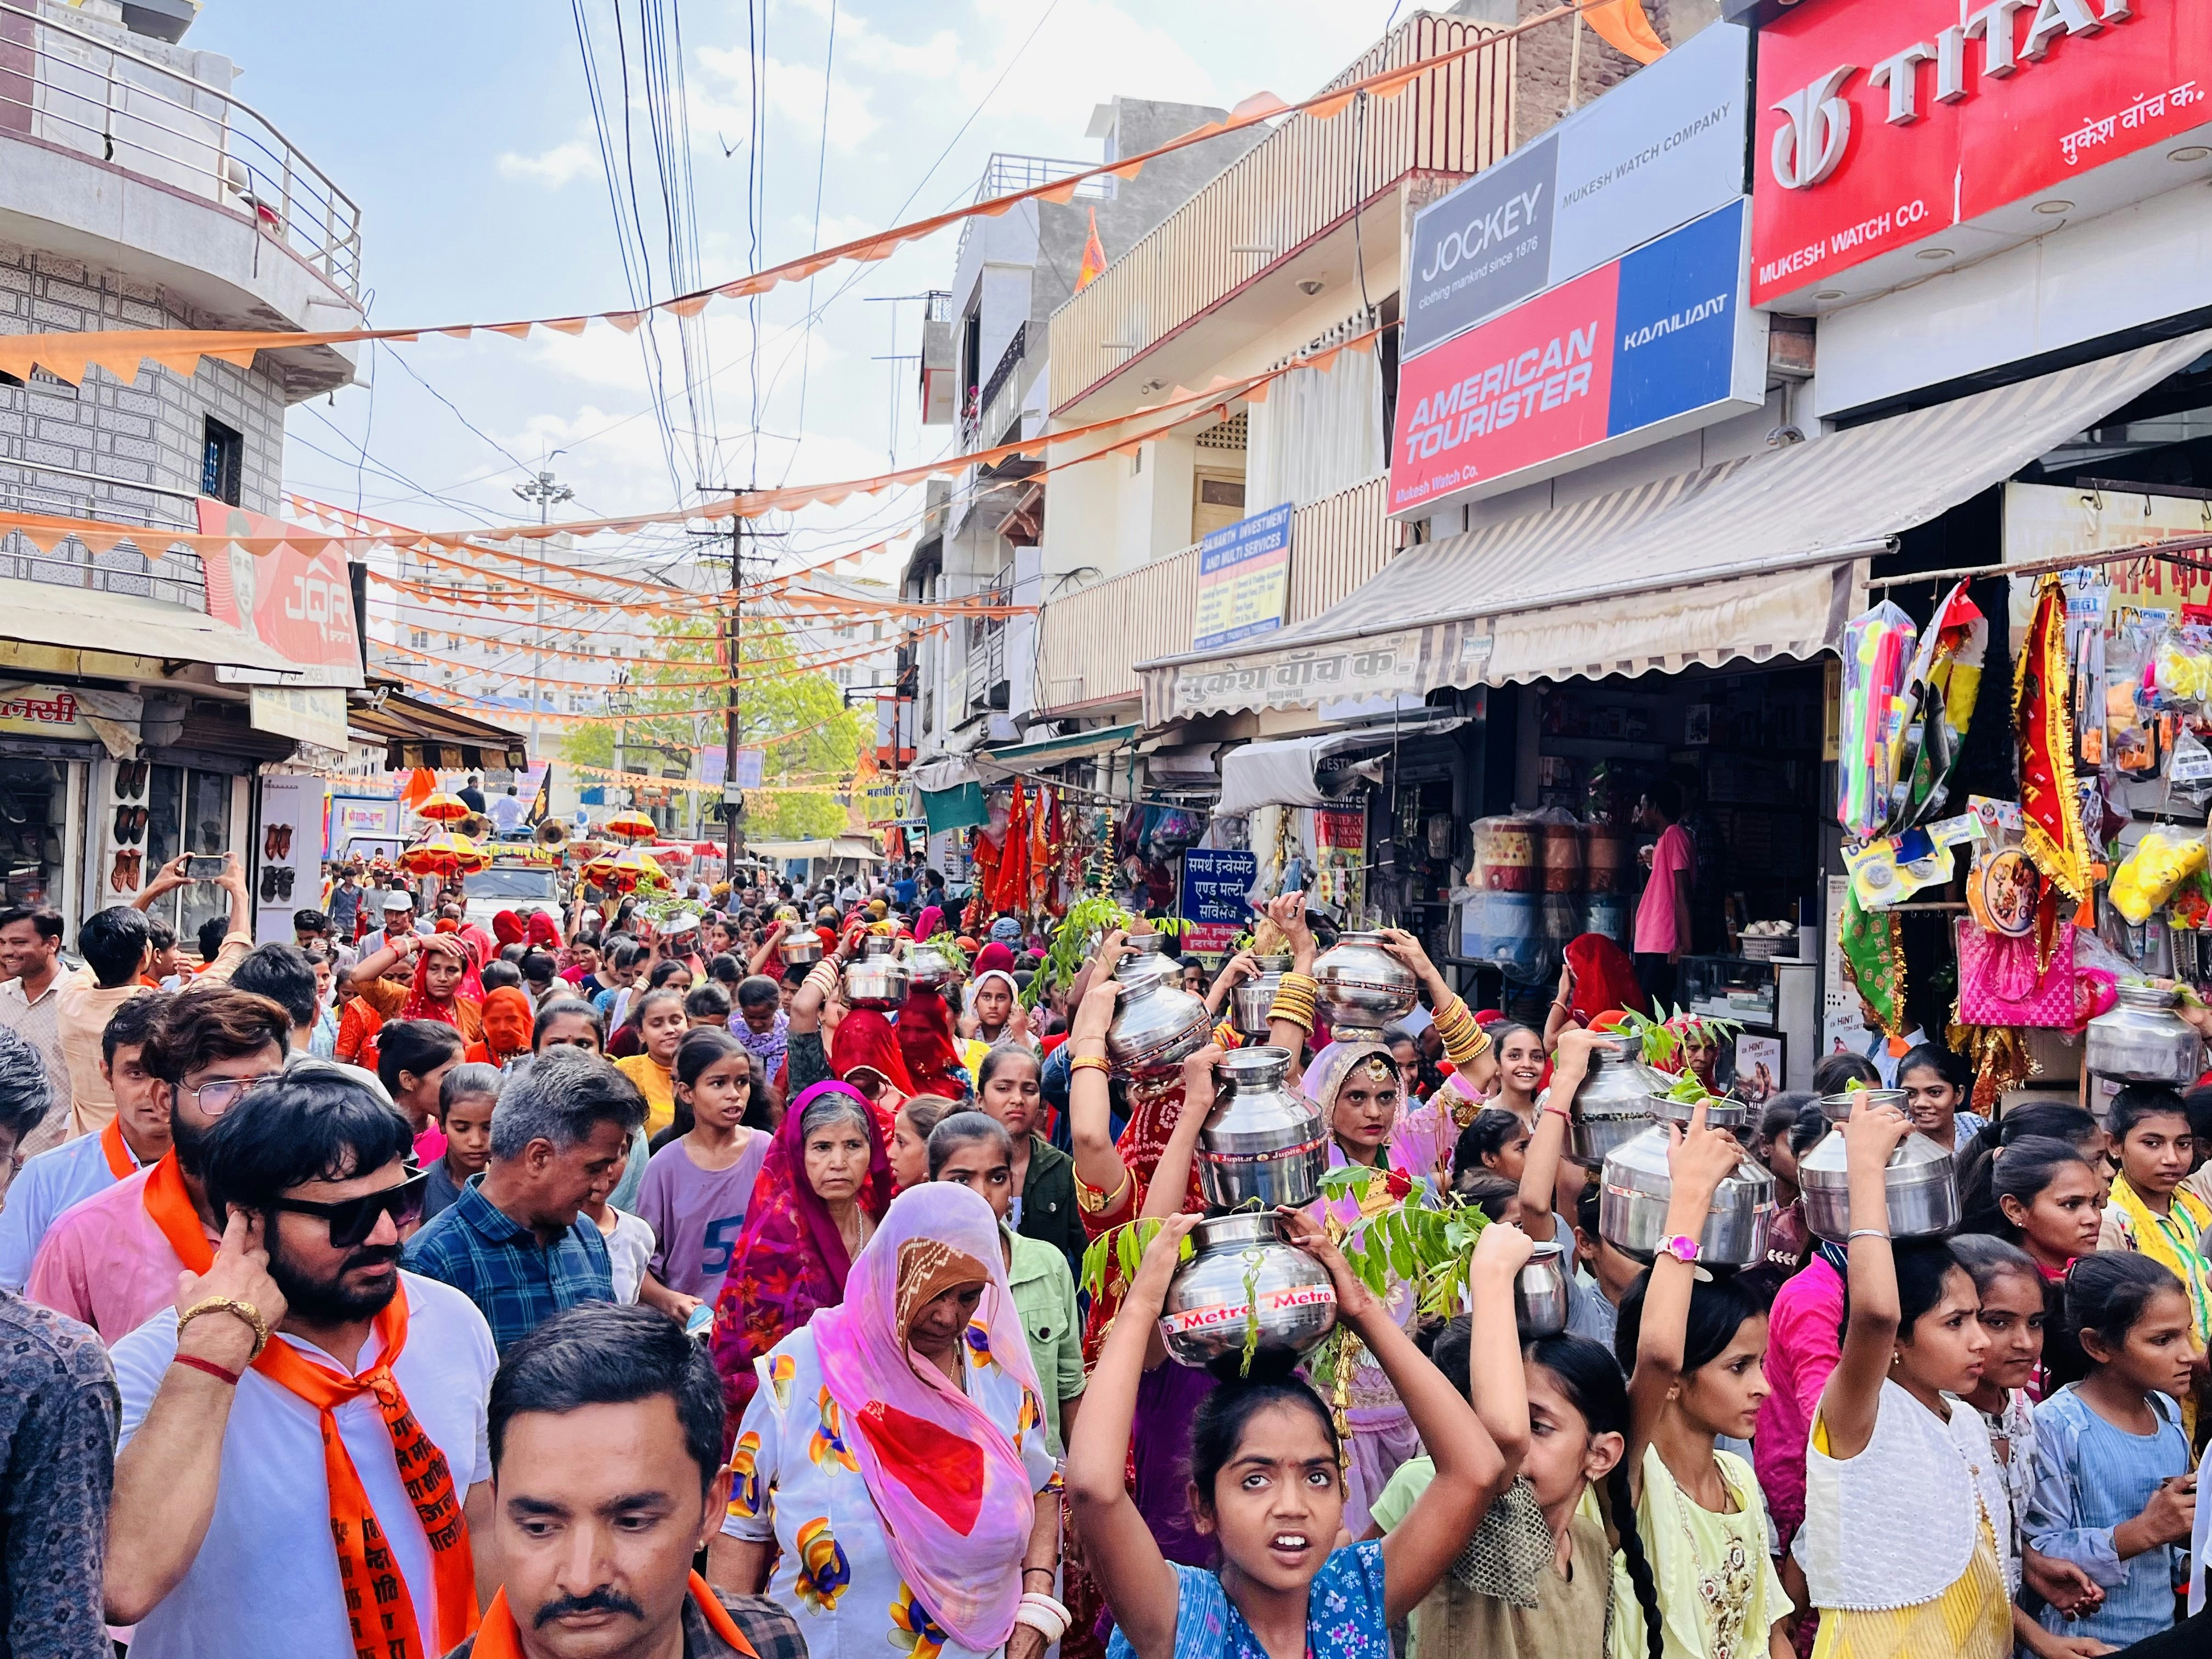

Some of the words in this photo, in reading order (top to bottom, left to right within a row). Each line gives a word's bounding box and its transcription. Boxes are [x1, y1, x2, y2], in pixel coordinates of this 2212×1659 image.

[1868, 0, 2134, 126] TITA
[2059, 116, 2117, 166] मुकेश
[2119, 92, 2167, 129] वॉच
[1563, 171, 1612, 208] MUKESH
[1616, 144, 1660, 179] WATCH
[1664, 101, 1730, 151] COMPANY
[1422, 182, 1542, 282] JOCKEY
[1759, 240, 1826, 285] MUKESH
[1831, 212, 1891, 255] WATCH
[1895, 199, 1929, 227] CO.
[1418, 285, 1451, 309] clothing
[1451, 262, 1488, 293] mankind
[1489, 252, 1513, 273] since
[1515, 235, 1539, 259] 1876
[1624, 294, 1728, 351] KAMILIANT
[1408, 321, 1598, 432] AMERICAN
[1406, 361, 1593, 464] TOURISTER
[1396, 481, 1430, 504] Mukesh
[1431, 469, 1461, 492] Watch
[1462, 464, 1479, 479] Co.
[1204, 528, 1236, 553] SAMARTH
[1239, 507, 1289, 539] INVESTMENT
[1205, 554, 1221, 572] AND
[1221, 546, 1243, 567] MULTI
[1244, 531, 1282, 558] SERVICES
[1180, 663, 1272, 704] मुकेश
[1276, 651, 1348, 687] वॉच
[867, 785, 895, 798] महावीर
[895, 817, 927, 826] SONATA
[1188, 853, 1214, 873] समर्थ
[1854, 854, 1882, 870] GOVIND
[1194, 881, 1218, 900] एण्ड
[1219, 878, 1245, 898] मल्टी
[1837, 1015, 1854, 1025] HINT
[1748, 1041, 1764, 1052] HINT
[702, 1214, 744, 1274] 5
[1273, 1291, 1331, 1308] Metro
